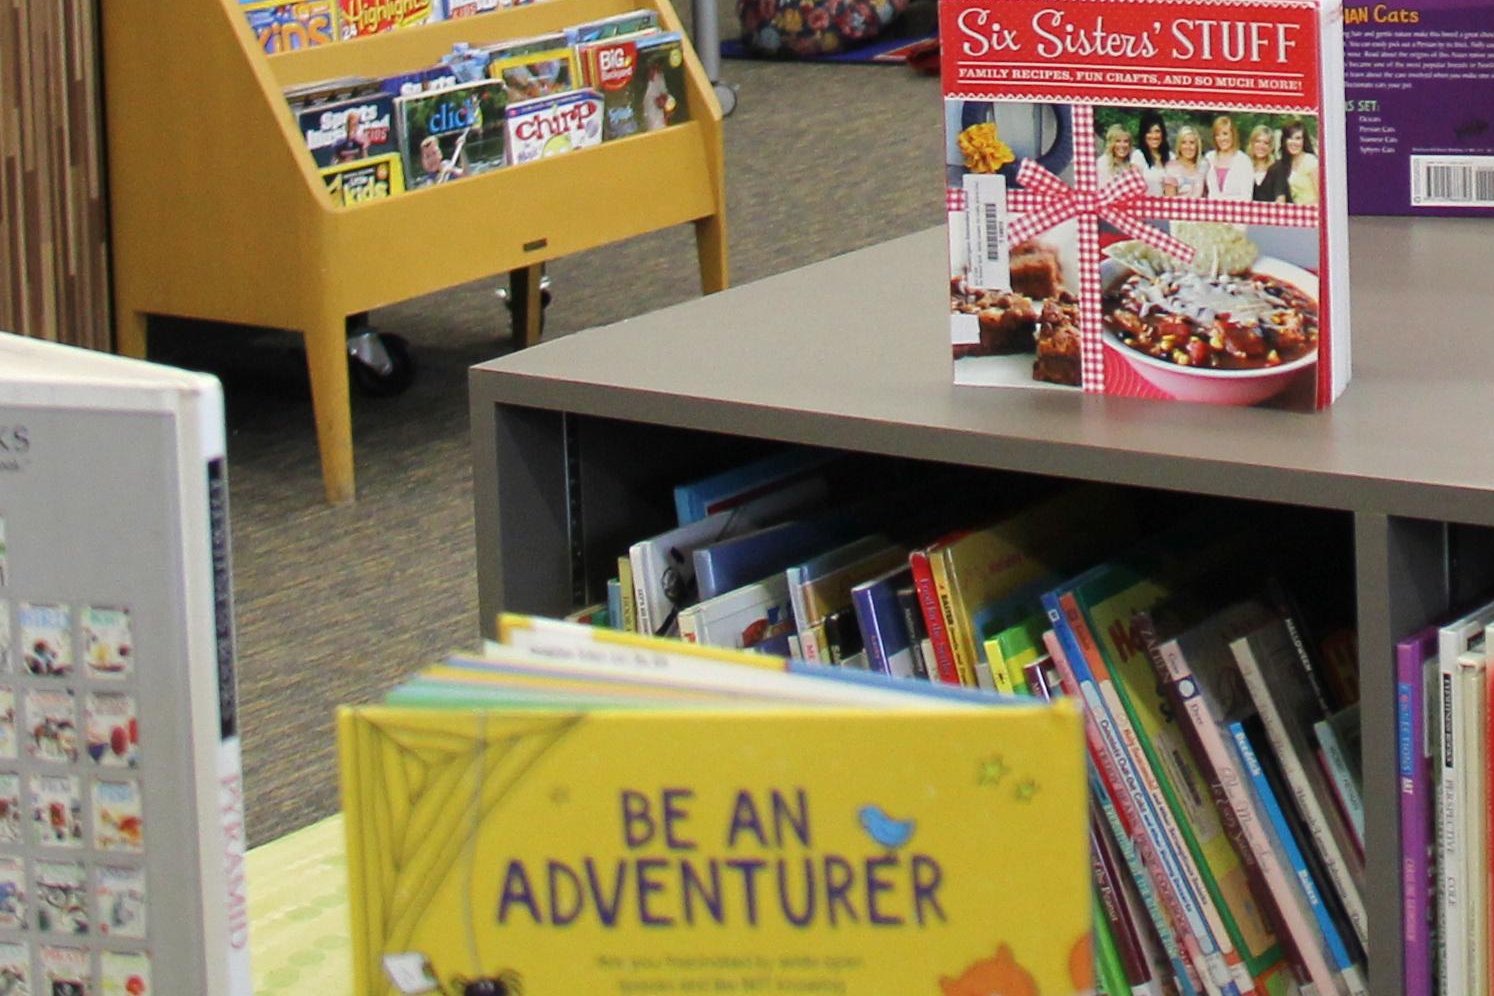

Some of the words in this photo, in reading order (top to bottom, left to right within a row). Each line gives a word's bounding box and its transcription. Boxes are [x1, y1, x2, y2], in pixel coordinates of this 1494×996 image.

[957, 7, 1022, 57] Six
[1031, 8, 1162, 59] Sisters'
[1171, 18, 1301, 64] STUFF
[1373, 3, 1420, 24] Cats
[958, 68, 1009, 79] FAMILY
[1012, 68, 1074, 82] RECIPES,
[1076, 70, 1103, 82] FUN
[1106, 71, 1161, 85] CRAFTS,
[1163, 74, 1192, 86] AND
[1194, 75, 1213, 87] SO
[1215, 76, 1255, 89] MUCH
[1258, 78, 1304, 91] MORE!
[515, 100, 598, 141] chirp
[1281, 617, 1316, 673] HALLOWEEN
[1401, 777, 1414, 795] ART
[620, 787, 698, 850] BE
[727, 787, 811, 848] AN
[497, 853, 948, 929] ADVENTURER
